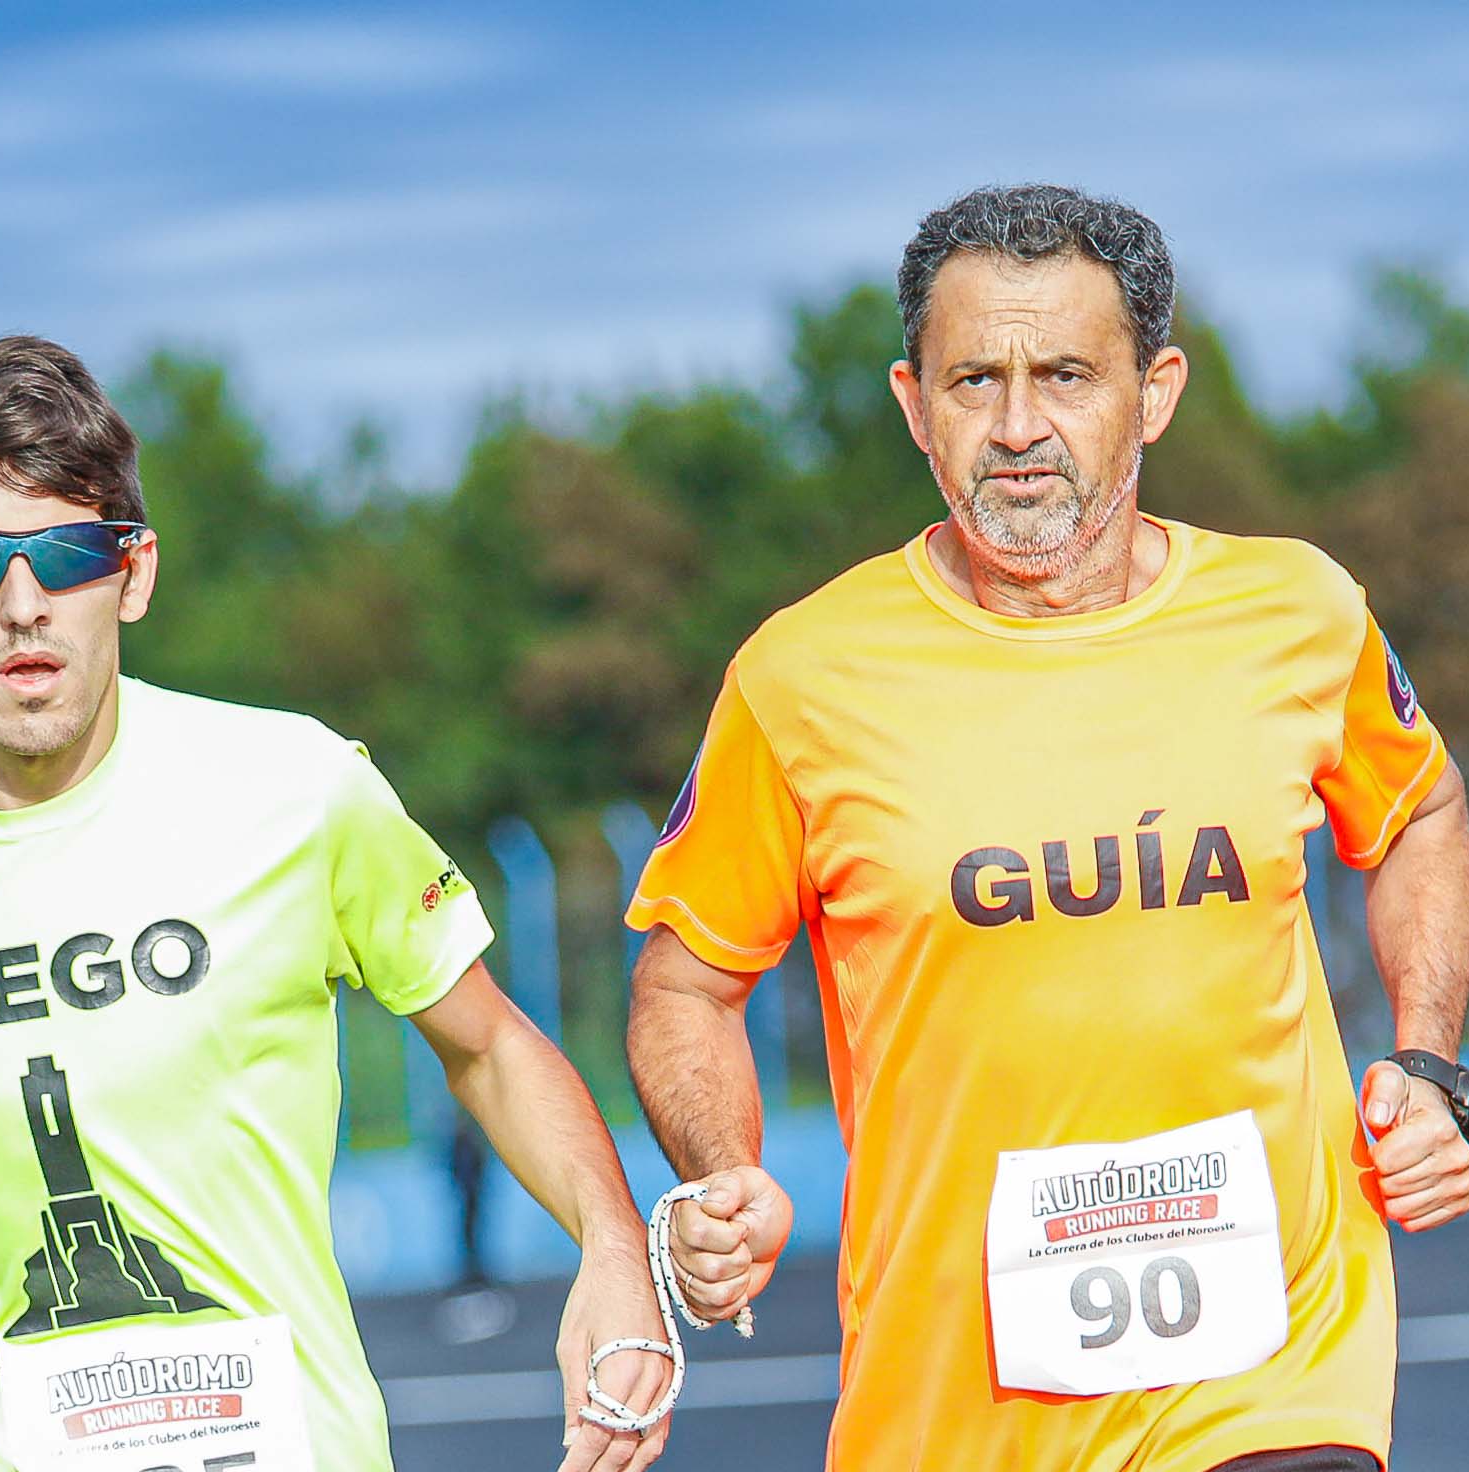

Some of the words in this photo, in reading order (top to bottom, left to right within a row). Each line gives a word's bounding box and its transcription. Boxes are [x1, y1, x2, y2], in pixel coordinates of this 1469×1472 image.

[951, 808, 1250, 928] GUÍA
[1032, 1151, 1227, 1217] AUTÓDROMO
[1029, 1248, 1041, 1258] La
[1044, 1239, 1087, 1256] Carrera
[1089, 1237, 1104, 1249] de
[1107, 1235, 1123, 1246] los
[1125, 1231, 1164, 1245] Clubes
[1167, 1226, 1185, 1239] del
[1187, 1222, 1236, 1236] Noroeste
[1065, 1203, 1148, 1236] RUNNING
[1155, 1199, 1202, 1221] RACE
[1070, 1256, 1201, 1349] 90
[47, 1352, 252, 1413] AUTÓDROMO
[82, 1401, 166, 1434] RUNNING
[172, 1396, 221, 1419] RACE
[112, 1439, 125, 1450] de
[129, 1436, 145, 1448] los
[148, 1431, 187, 1446] Clubes
[190, 1426, 208, 1439] del
[210, 1419, 261, 1435] Noroeste
